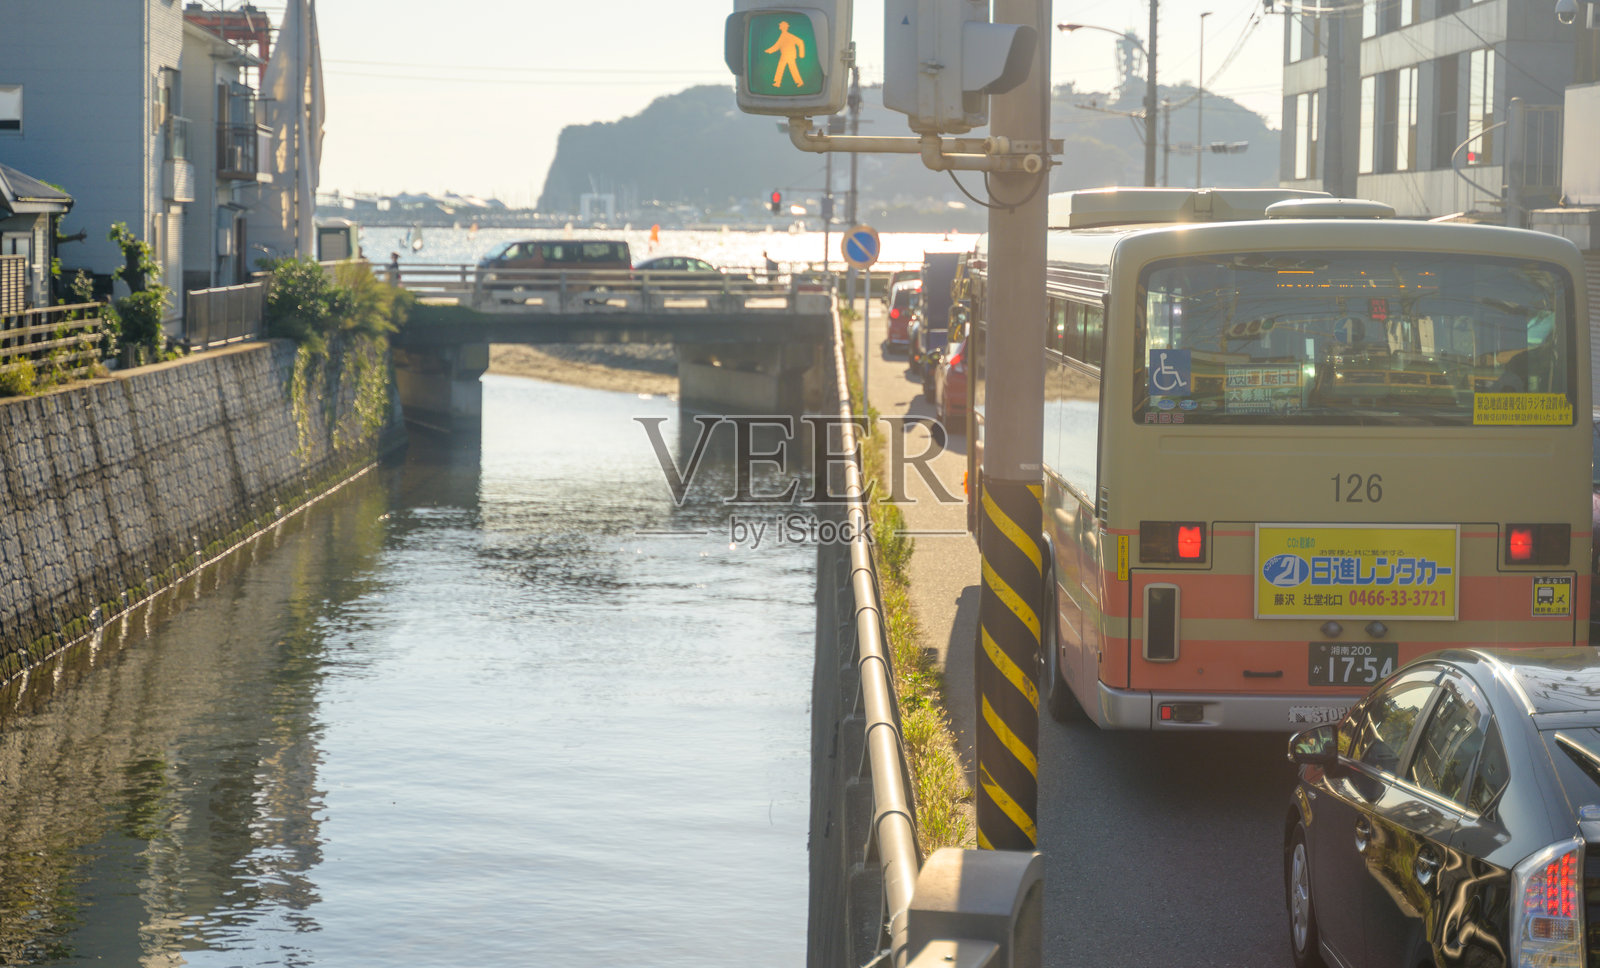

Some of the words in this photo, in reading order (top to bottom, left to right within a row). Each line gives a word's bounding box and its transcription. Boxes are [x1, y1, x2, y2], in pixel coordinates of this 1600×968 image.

[1145, 412, 1184, 424] ABS
[1331, 473, 1383, 503] 126
[1311, 557, 1452, 585] 日進レンタカー
[1274, 593, 1295, 606] 藤沢
[1304, 593, 1343, 606] 辻堂北口
[1349, 590, 1446, 606] 0466-33-3721
[1331, 646, 1350, 655] 湘南
[1352, 646, 1372, 655] 200
[1329, 657, 1392, 682] 17-54
